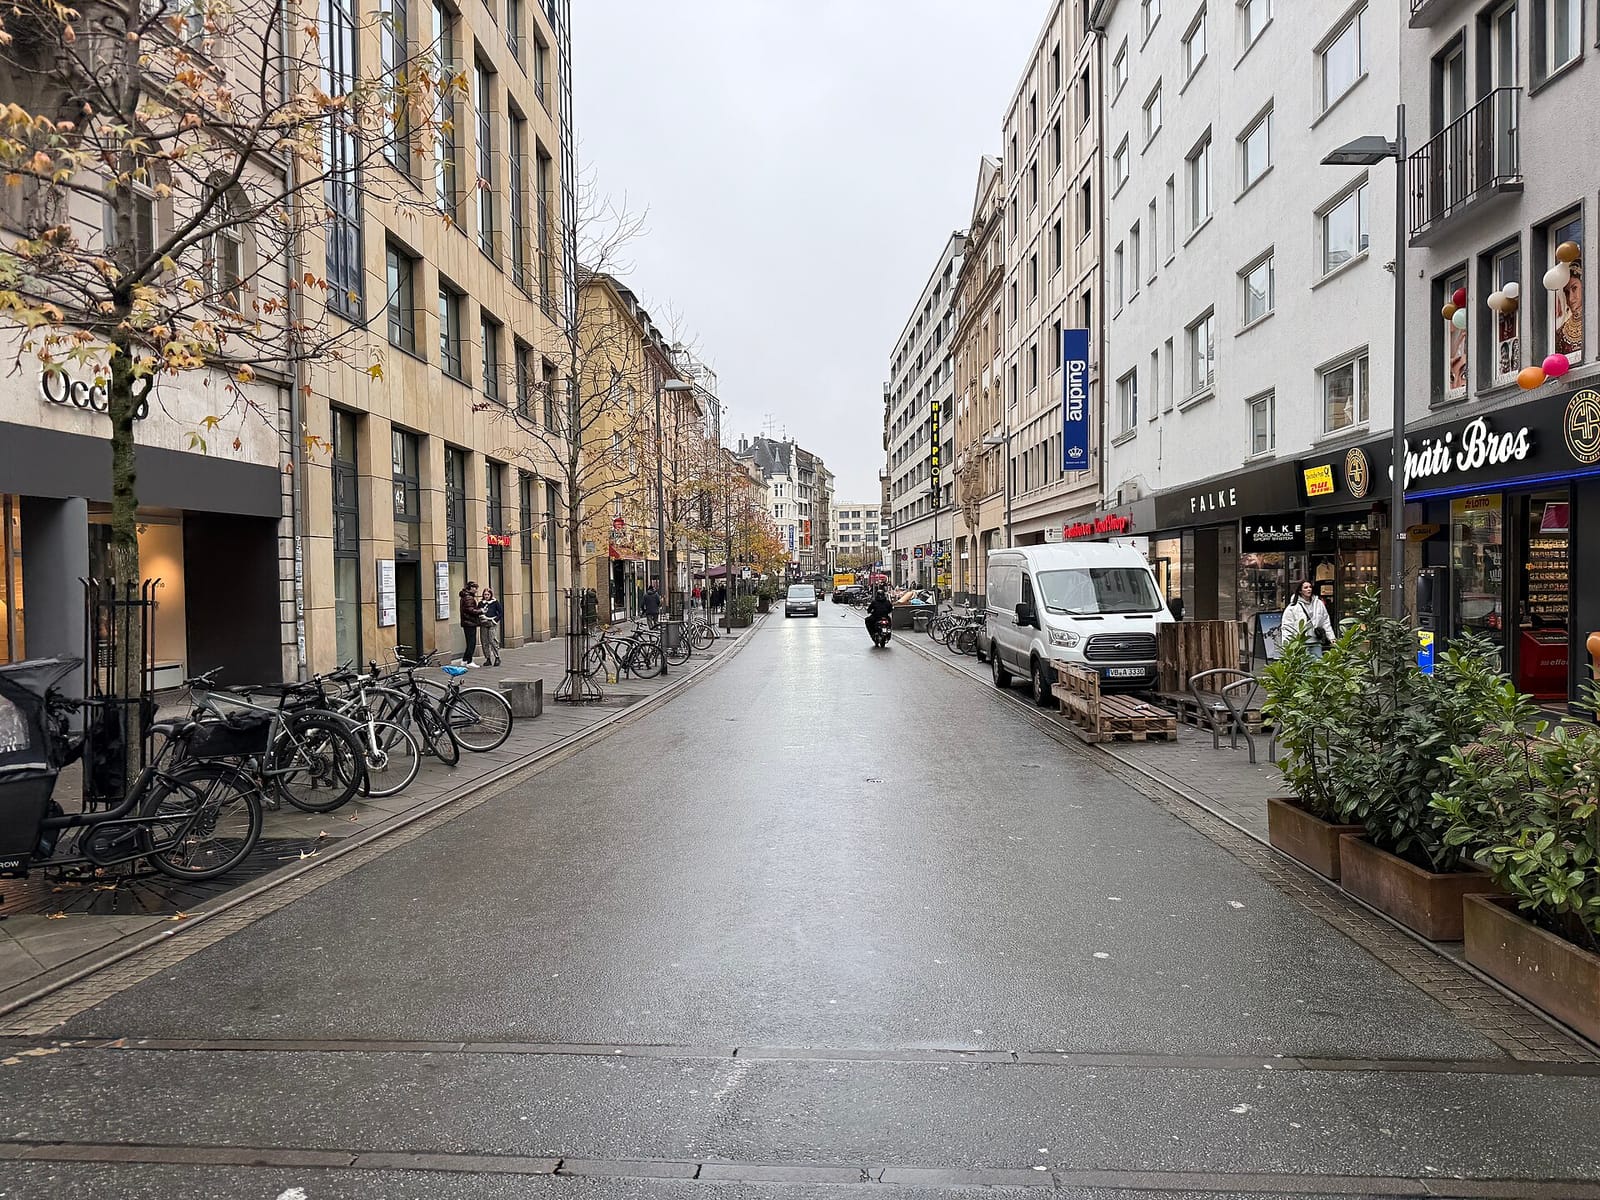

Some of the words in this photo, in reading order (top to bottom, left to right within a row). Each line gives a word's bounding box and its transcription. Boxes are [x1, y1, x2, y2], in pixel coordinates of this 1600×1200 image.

[1067, 360, 1085, 421] auping
[1456, 416, 1530, 473] Bros
[1190, 487, 1238, 513] FALKE
[1472, 498, 1490, 509] LOTTO
[1245, 524, 1302, 534] FALKE
